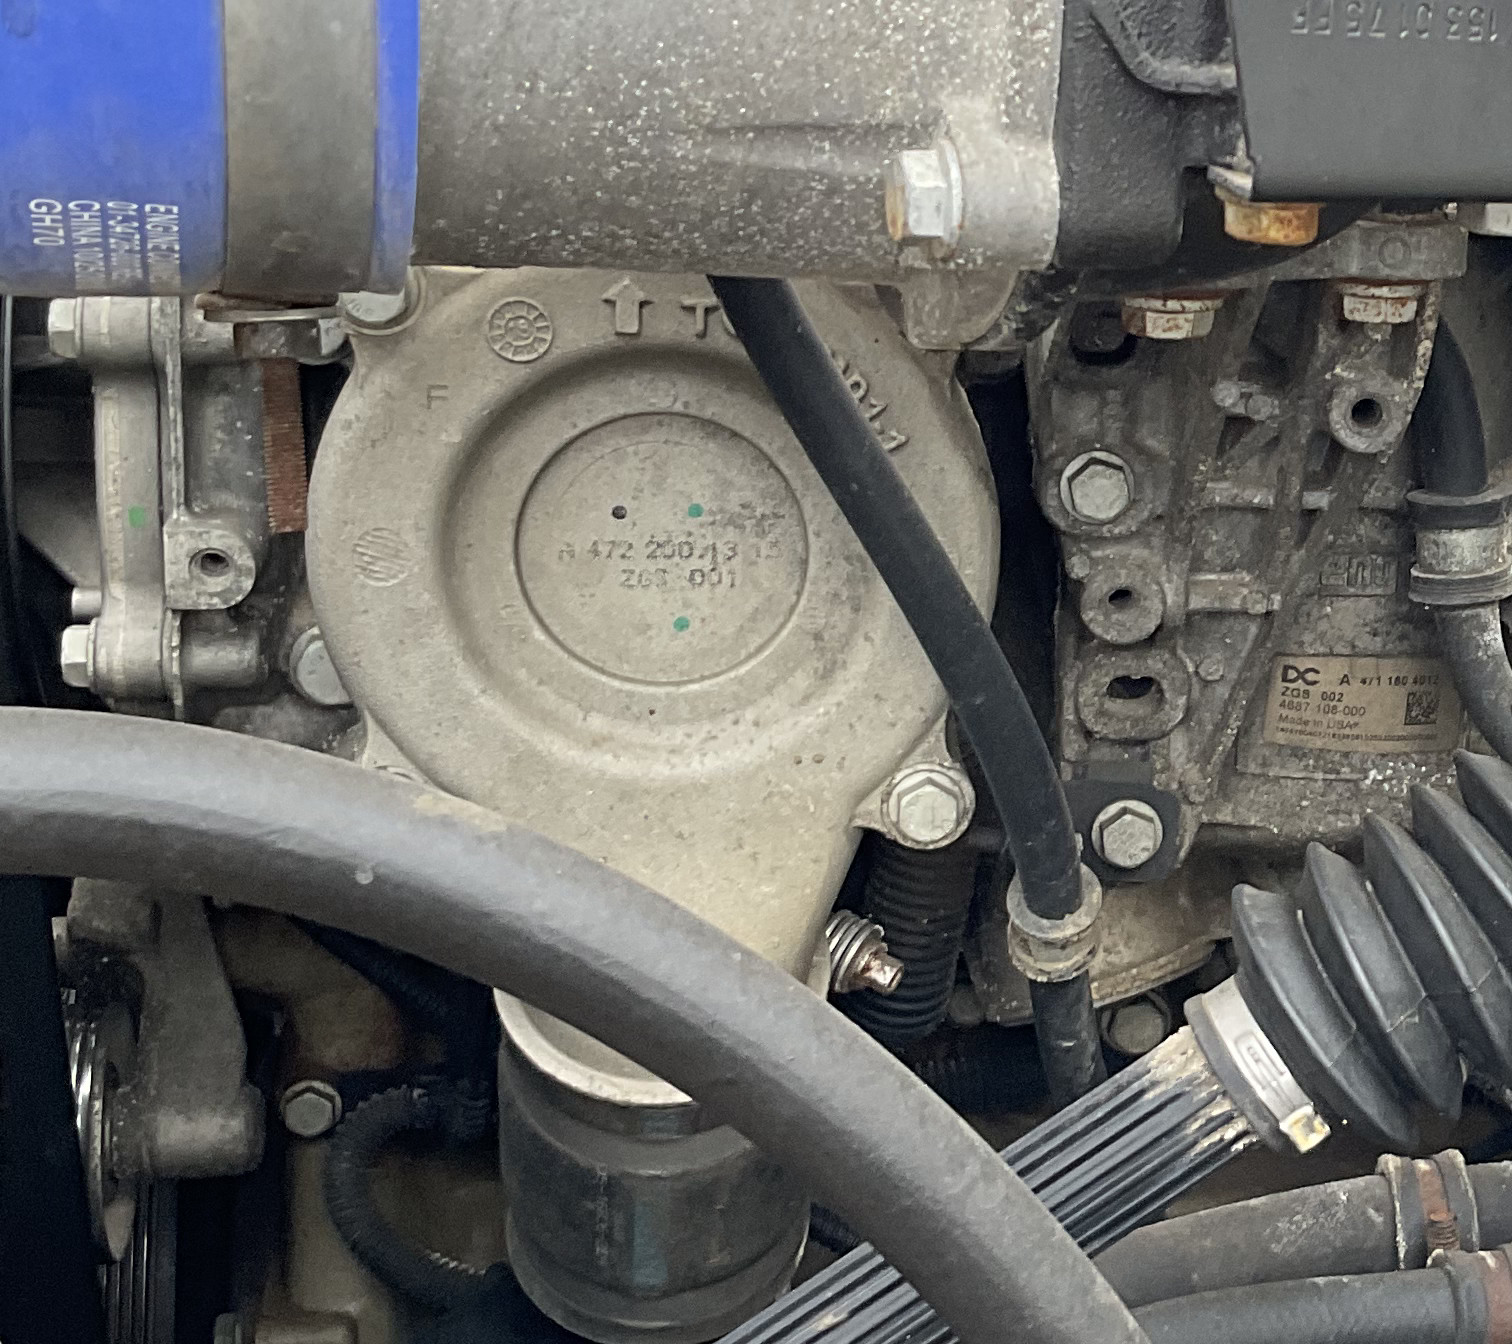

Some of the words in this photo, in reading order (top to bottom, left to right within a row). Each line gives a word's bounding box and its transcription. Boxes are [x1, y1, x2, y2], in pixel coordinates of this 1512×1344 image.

[1346, 0, 1386, 38] 75
[1446, 6, 1498, 42] 153
[28, 198, 66, 247] GH70
[68, 199, 103, 245] CHINA
[144, 203, 180, 250] ENGINE
[587, 539, 634, 561] 472
[1281, 664, 1320, 686] DC
[1339, 674, 1351, 686] A
[1321, 691, 1344, 703] 002
[1277, 713, 1312, 726] Made
